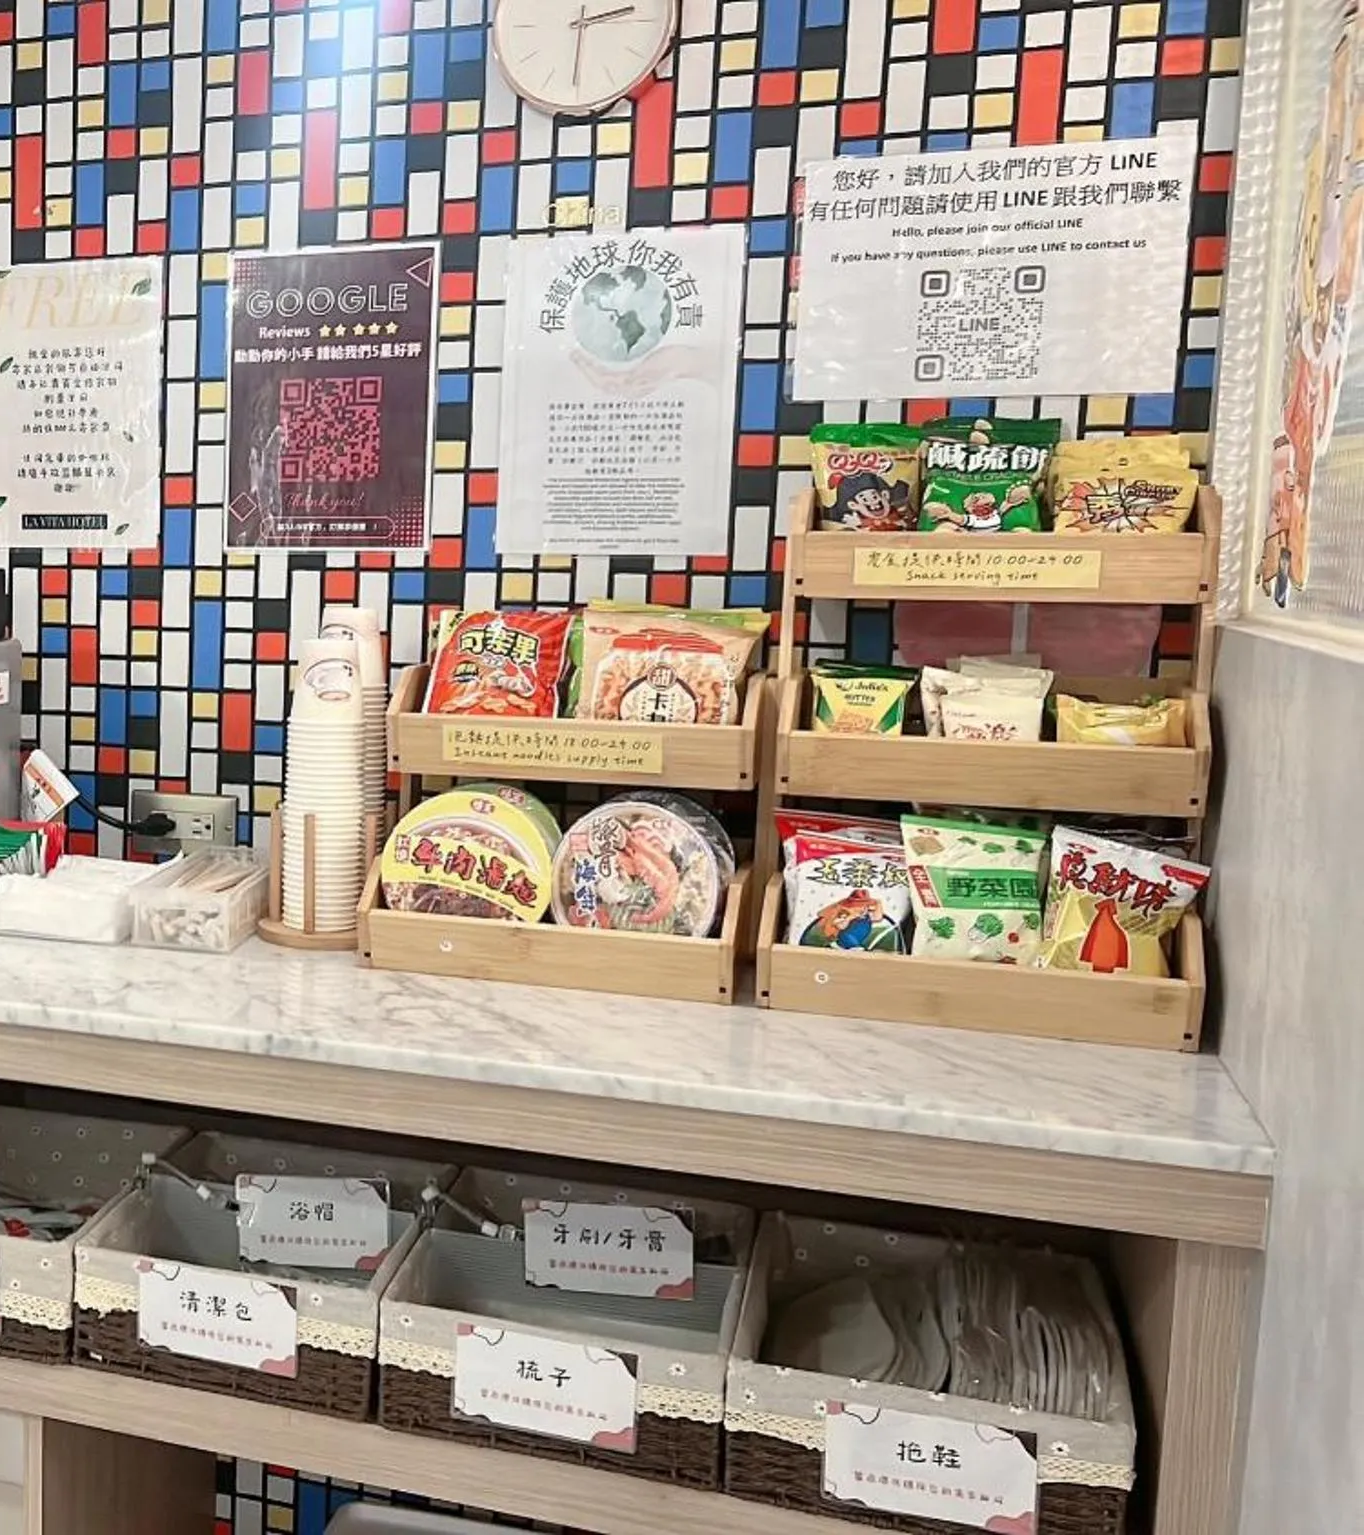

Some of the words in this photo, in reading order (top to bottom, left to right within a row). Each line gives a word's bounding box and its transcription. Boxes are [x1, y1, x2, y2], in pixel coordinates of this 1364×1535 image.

[1110, 151, 1157, 171] LINE
[809, 191, 998, 223] 有任何問題請使用
[1003, 191, 1049, 209] LINE
[1052, 178, 1183, 208] 跟我們聯繫
[927, 225, 964, 237] please
[967, 222, 988, 235] join
[991, 223, 1011, 232] our
[1014, 219, 1054, 231] official
[1057, 218, 1083, 229] LINE
[865, 251, 891, 261] have
[977, 247, 1016, 257] please
[1018, 245, 1037, 254] use
[1041, 241, 1067, 252] LINE
[1070, 242, 1083, 251] to
[1086, 239, 1130, 250] contact
[1133, 239, 1147, 248] us
[246, 283, 408, 318] GOOGLE
[259, 326, 311, 339] Reviews
[958, 317, 999, 331] LINE
[906, 570, 946, 581] Snack
[460, 624, 539, 666] 可樂果
[947, 877, 1037, 899] 野菜園
[289, 1201, 334, 1222] 浴帽
[179, 1290, 252, 1323] 清潔包
[516, 1358, 572, 1388] 梳子
[896, 1441, 963, 1470] 拖鞋
